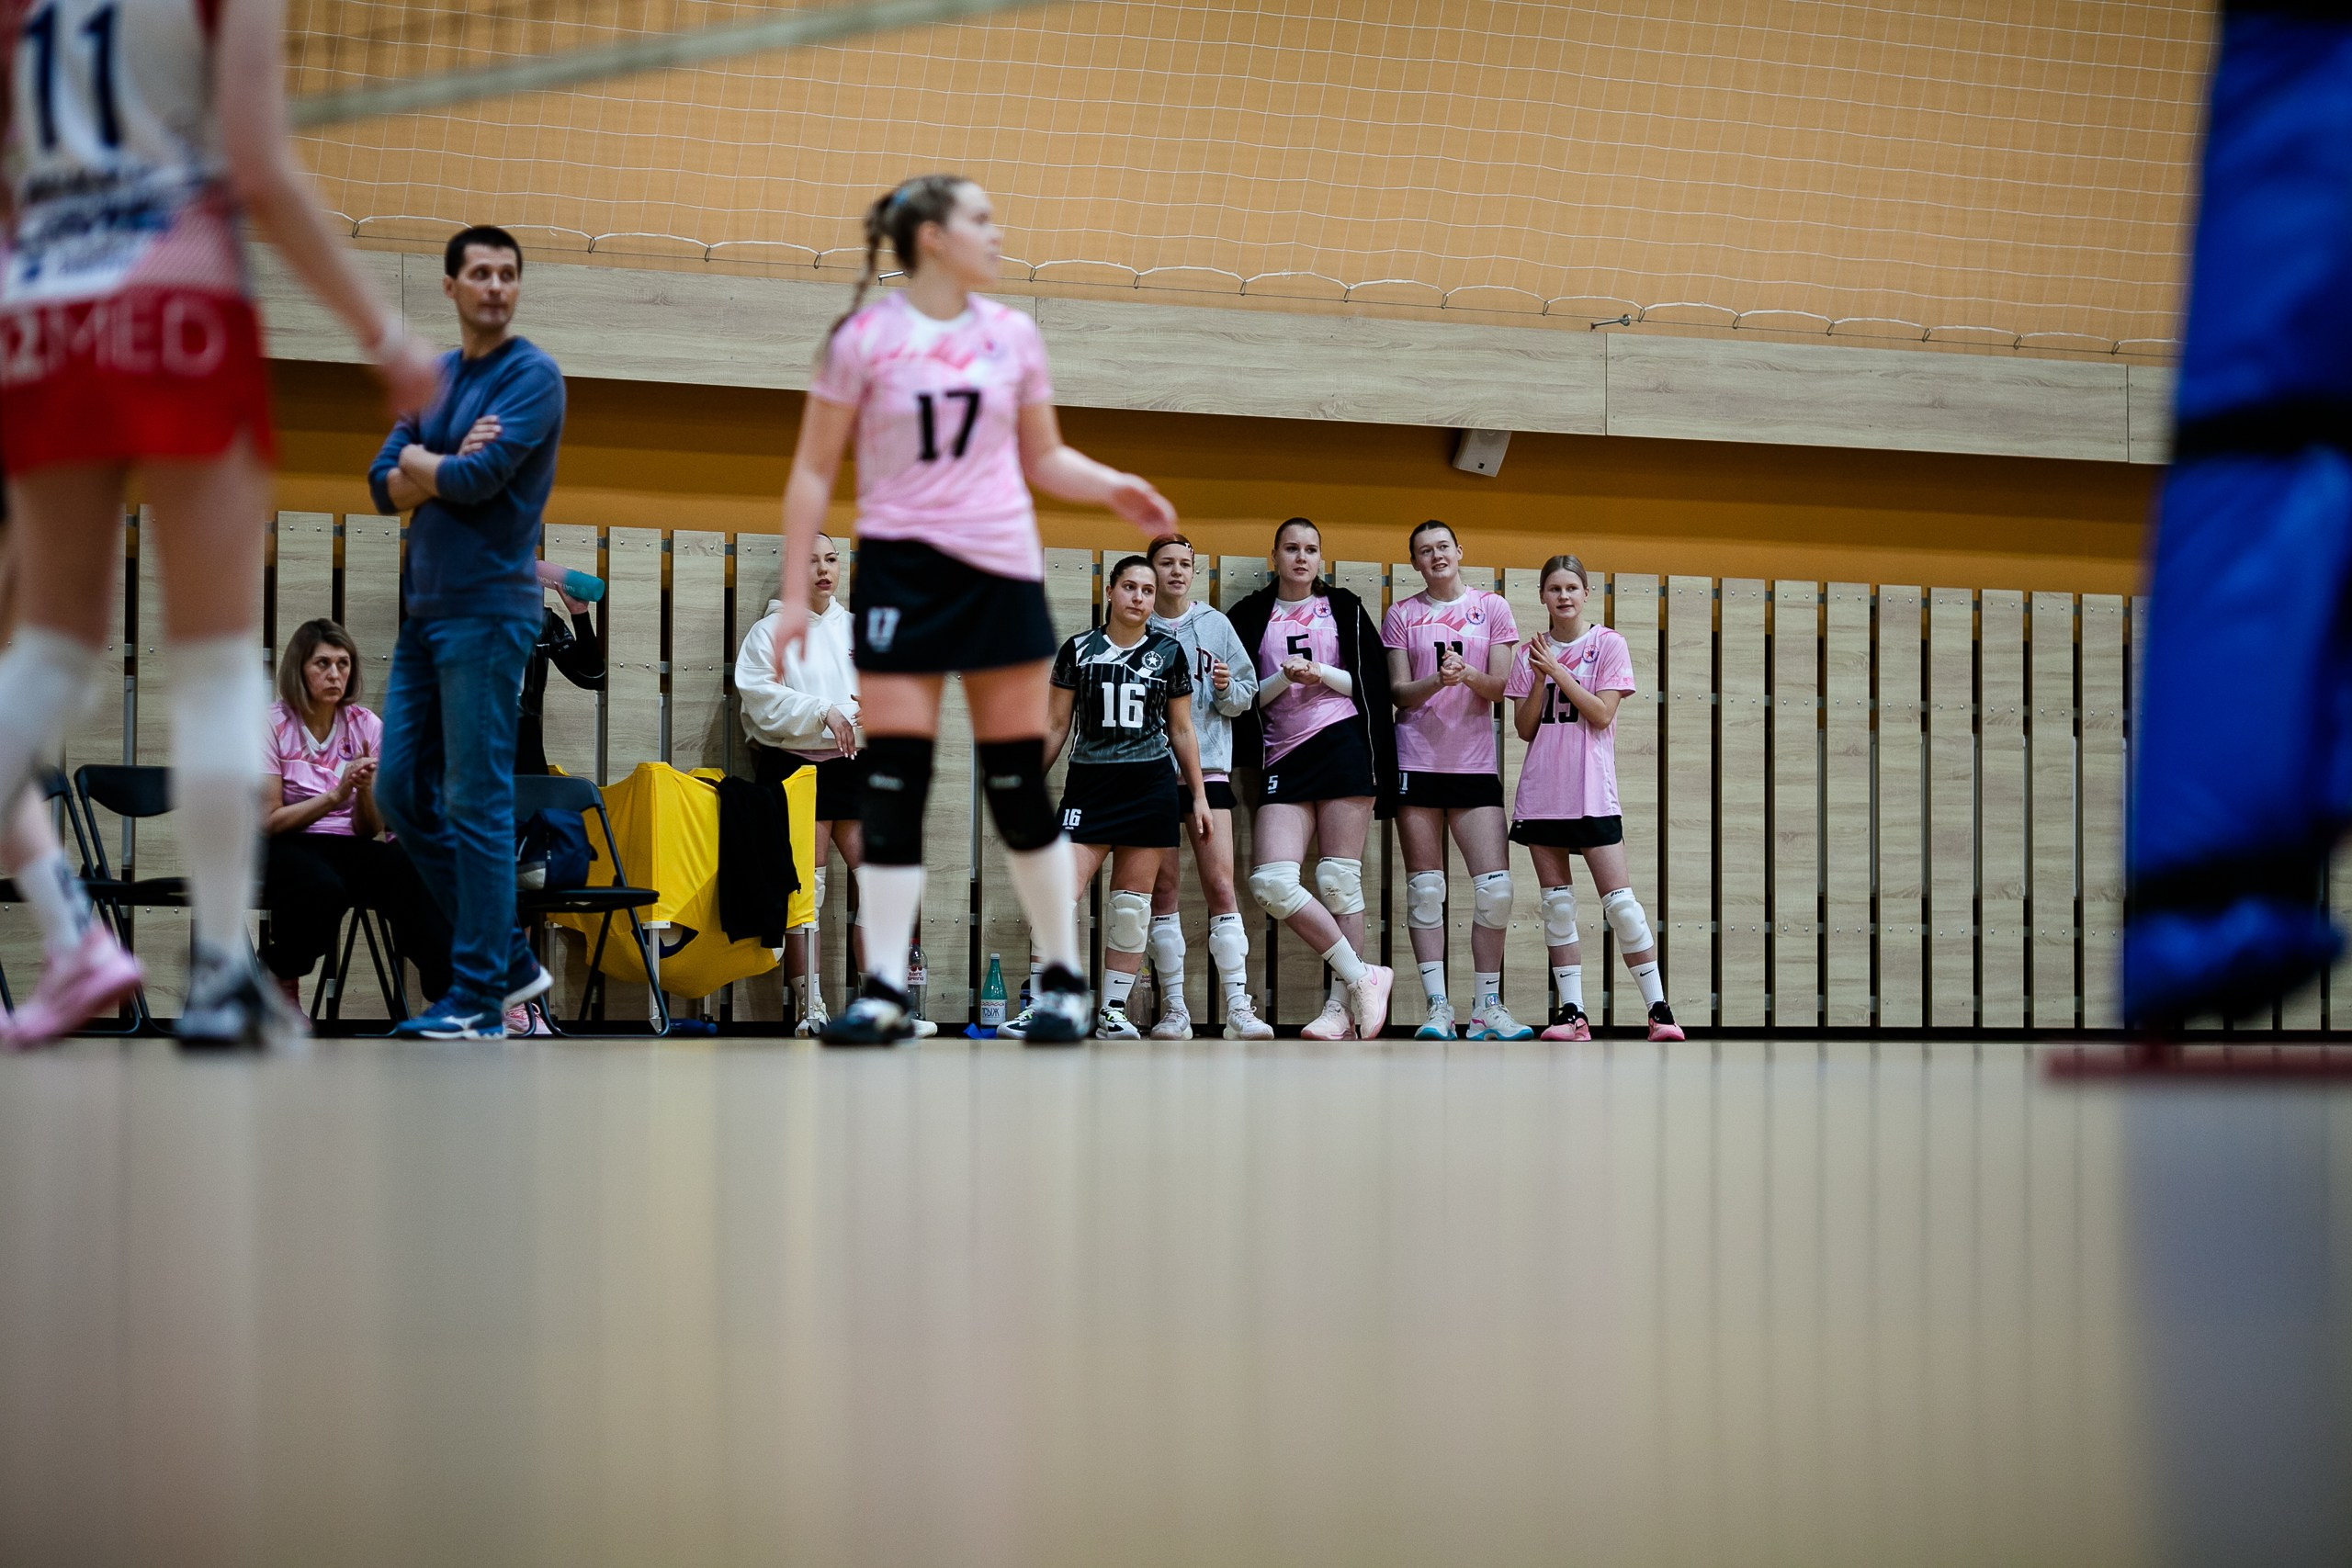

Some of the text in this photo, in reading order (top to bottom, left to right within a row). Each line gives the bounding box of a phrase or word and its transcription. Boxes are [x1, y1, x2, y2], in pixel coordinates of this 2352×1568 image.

[20, 2, 122, 152] 11
[917, 389, 980, 462] 17
[1285, 633, 1313, 662] 5
[1102, 682, 1146, 728] 16
[1267, 775, 1279, 791] 5
[1062, 808, 1082, 827] 16
